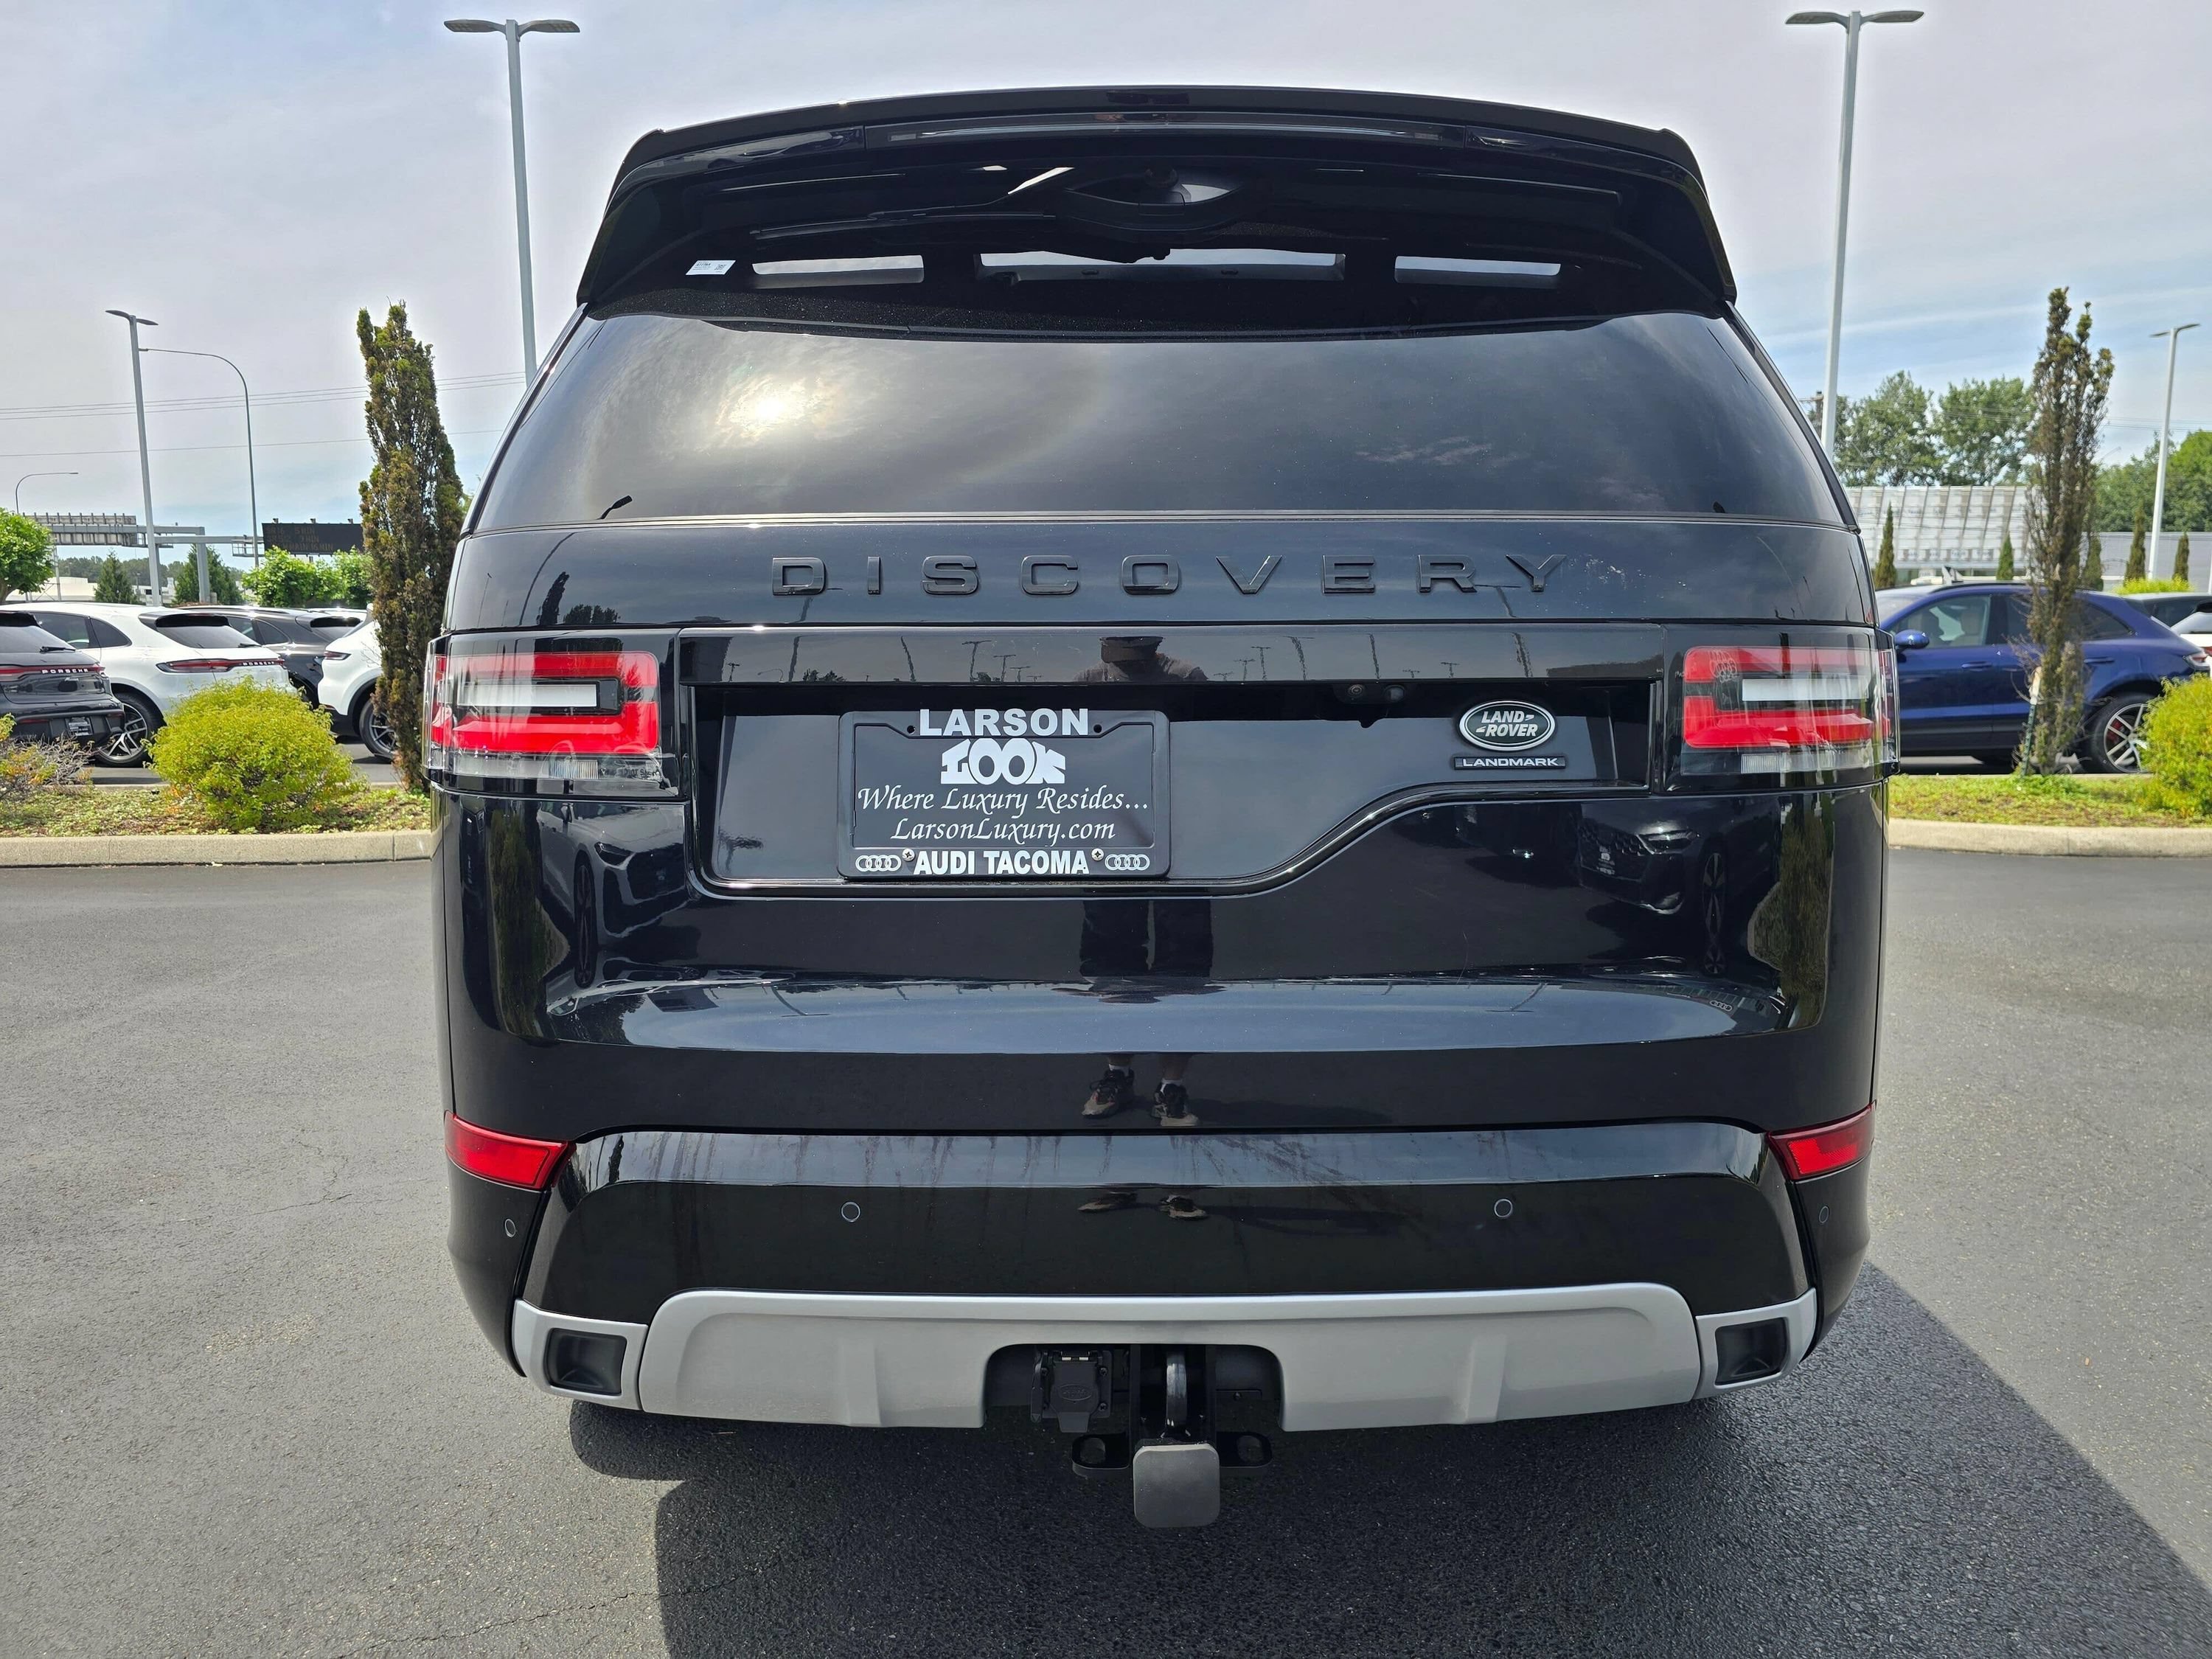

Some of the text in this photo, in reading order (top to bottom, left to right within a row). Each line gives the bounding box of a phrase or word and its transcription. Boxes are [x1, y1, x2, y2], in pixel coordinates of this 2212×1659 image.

[771, 554, 1568, 596] DISCOVERY
[919, 708, 1088, 737] LARSON
[1481, 711, 1525, 723] LAND
[1484, 723, 1539, 737] ROVER
[940, 737, 1066, 785] LOOK
[1462, 758, 1559, 767] LANDMARK
[857, 785, 1149, 818] Where Luxury Resides...
[890, 818, 1116, 847] LarsonLuxury.com
[914, 850, 1090, 875] AUDI TACOMA
